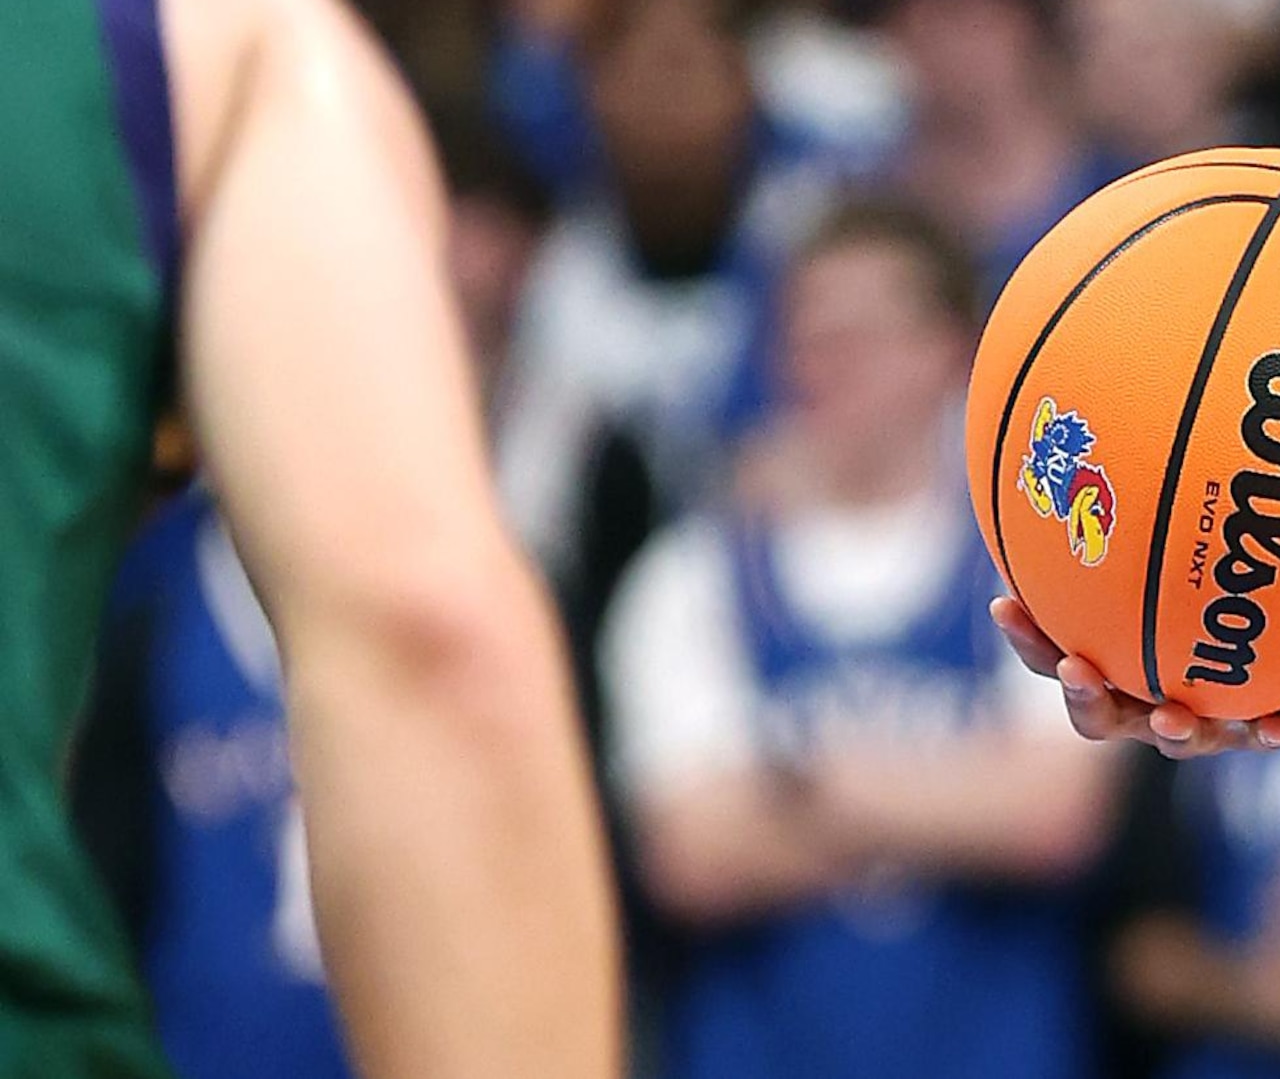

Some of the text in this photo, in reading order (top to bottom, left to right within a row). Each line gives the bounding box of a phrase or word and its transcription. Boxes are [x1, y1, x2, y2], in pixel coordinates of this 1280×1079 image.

[1046, 445, 1070, 486] KU
[1187, 481, 1221, 590] EVO NXT
